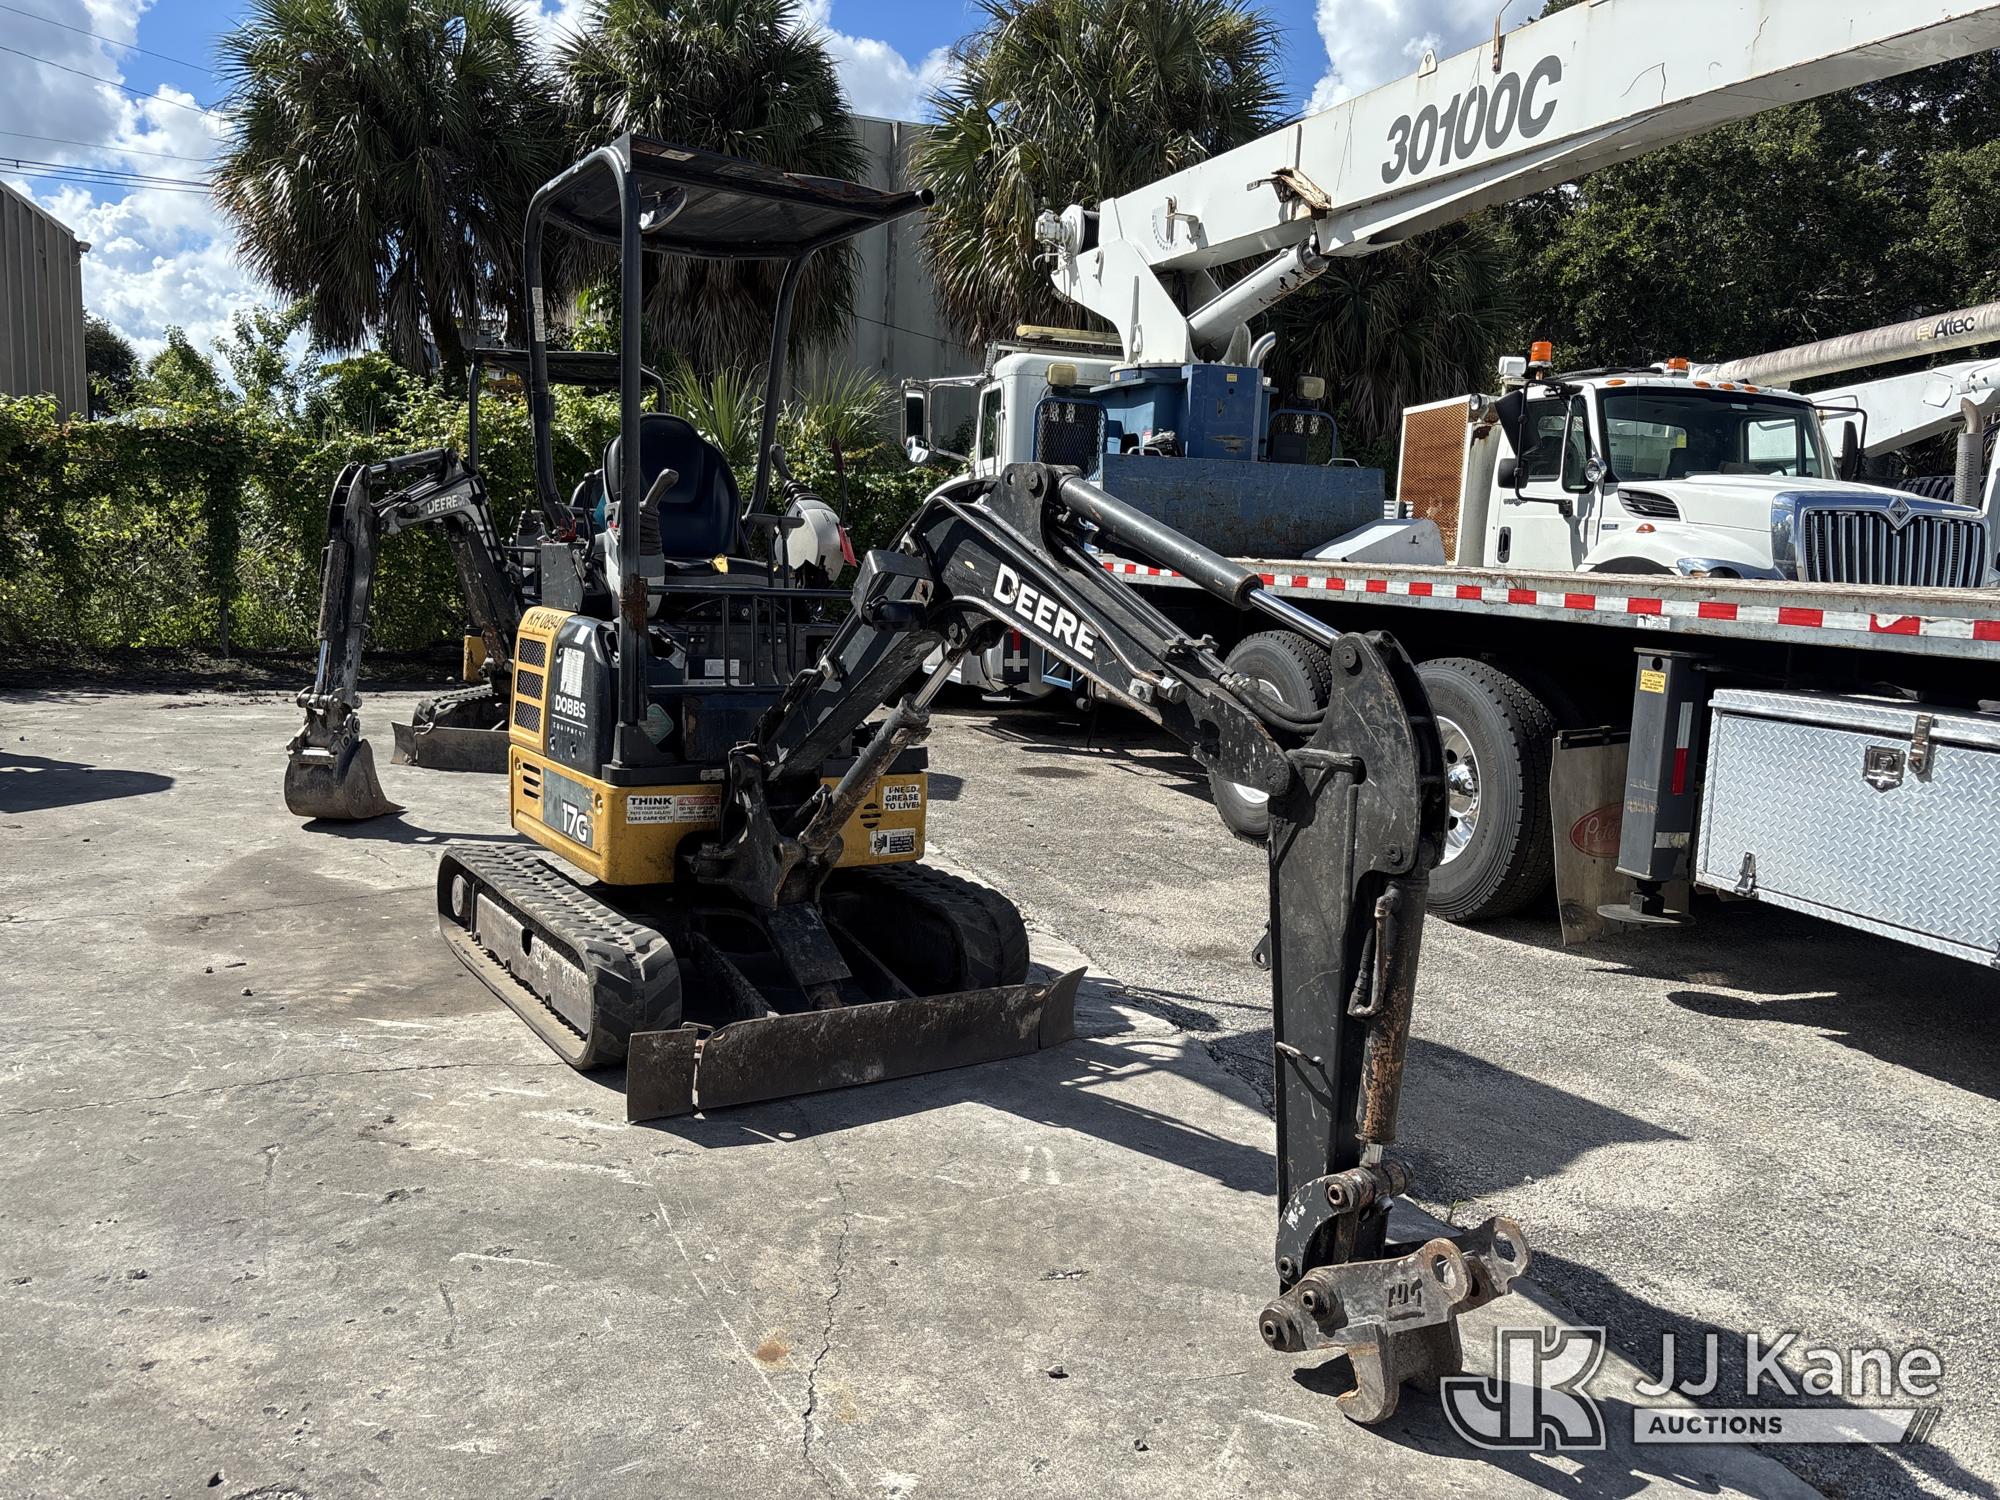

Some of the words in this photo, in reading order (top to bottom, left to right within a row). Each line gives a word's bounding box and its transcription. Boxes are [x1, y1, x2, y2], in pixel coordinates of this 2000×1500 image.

[1381, 55, 1562, 184] 30100C
[1934, 317, 1975, 339] Altec
[427, 494, 458, 515] DEERE
[526, 610, 544, 627] KH
[993, 563, 1099, 659] DEERE
[554, 694, 586, 719] DOBBS
[885, 794, 919, 802] GREASE
[894, 786, 917, 794] NEED
[629, 797, 673, 805] THINK
[562, 800, 588, 842] 17G
